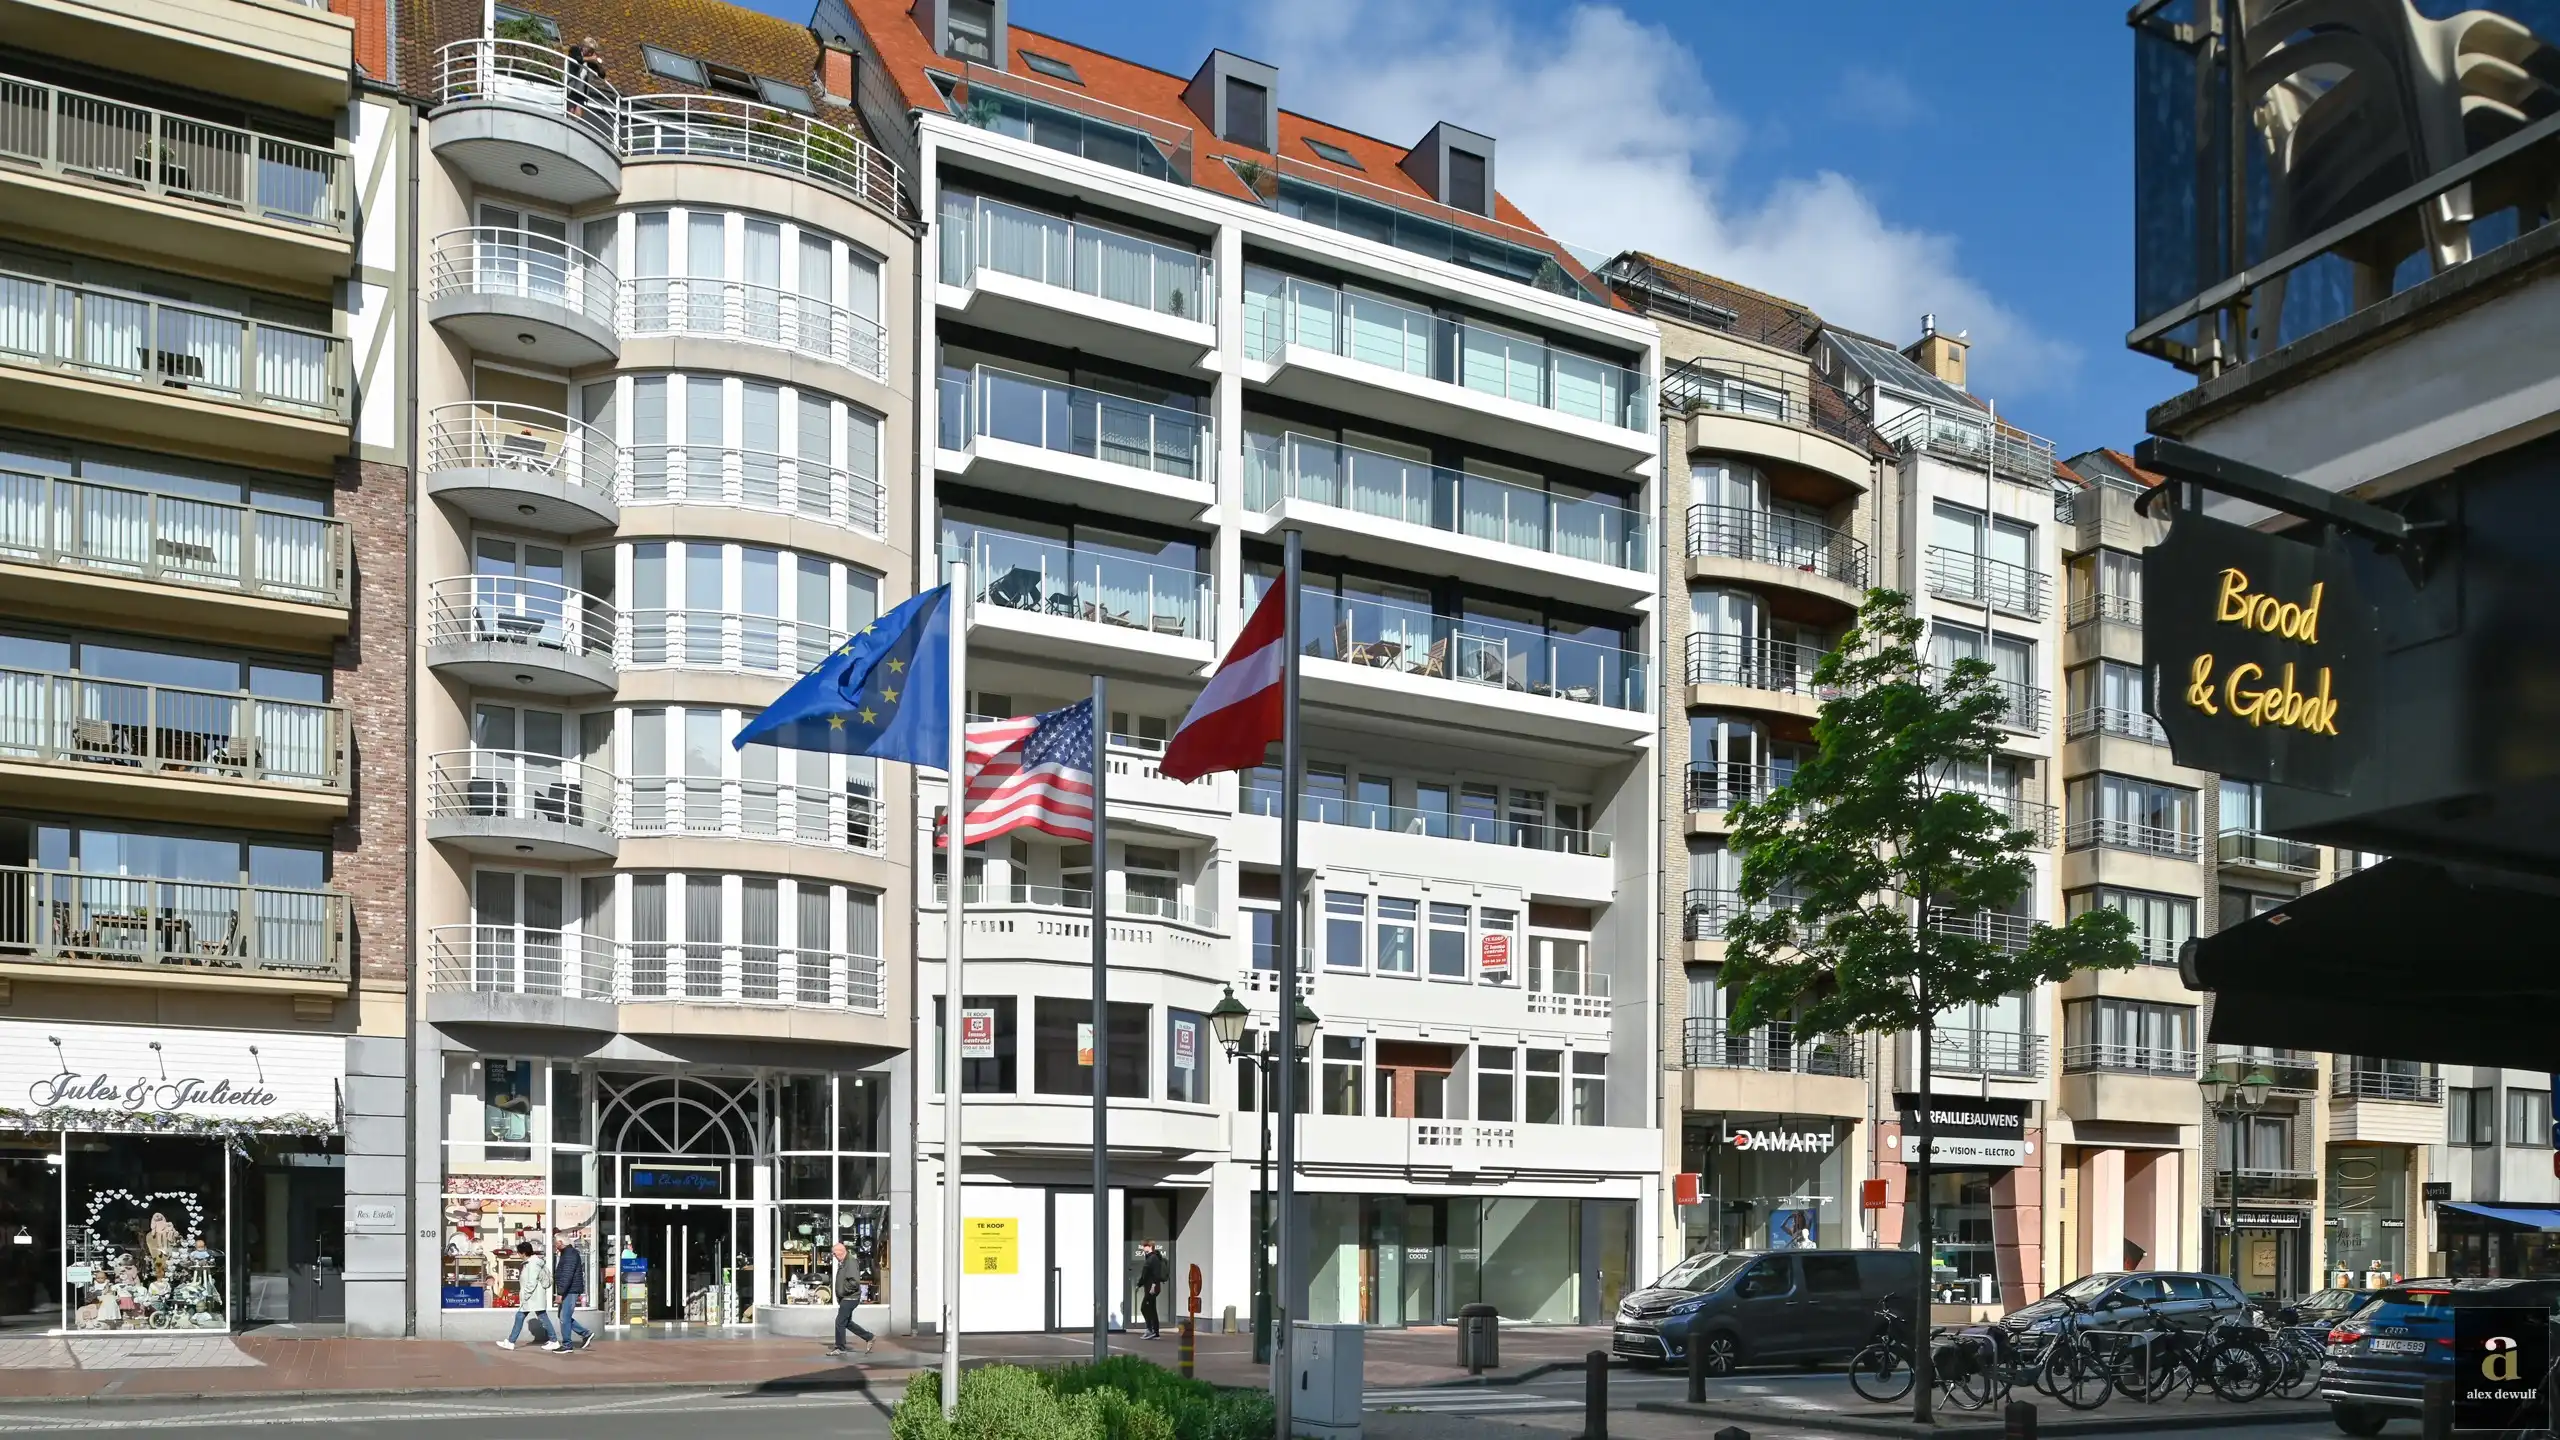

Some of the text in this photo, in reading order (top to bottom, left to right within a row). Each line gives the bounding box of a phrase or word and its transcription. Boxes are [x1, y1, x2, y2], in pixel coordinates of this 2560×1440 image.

[2216, 567, 2324, 645] Brood
[2187, 653, 2339, 736] & Gebak
[29, 1072, 278, 1111] Jules & Juliette
[1733, 1129, 1831, 1154] DAMART
[1949, 1146, 1976, 1155] VISION
[1985, 1147, 2016, 1157] ELECTRO
[2257, 1214, 2270, 1223] ART
[2271, 1214, 2298, 1224] GALLERY
